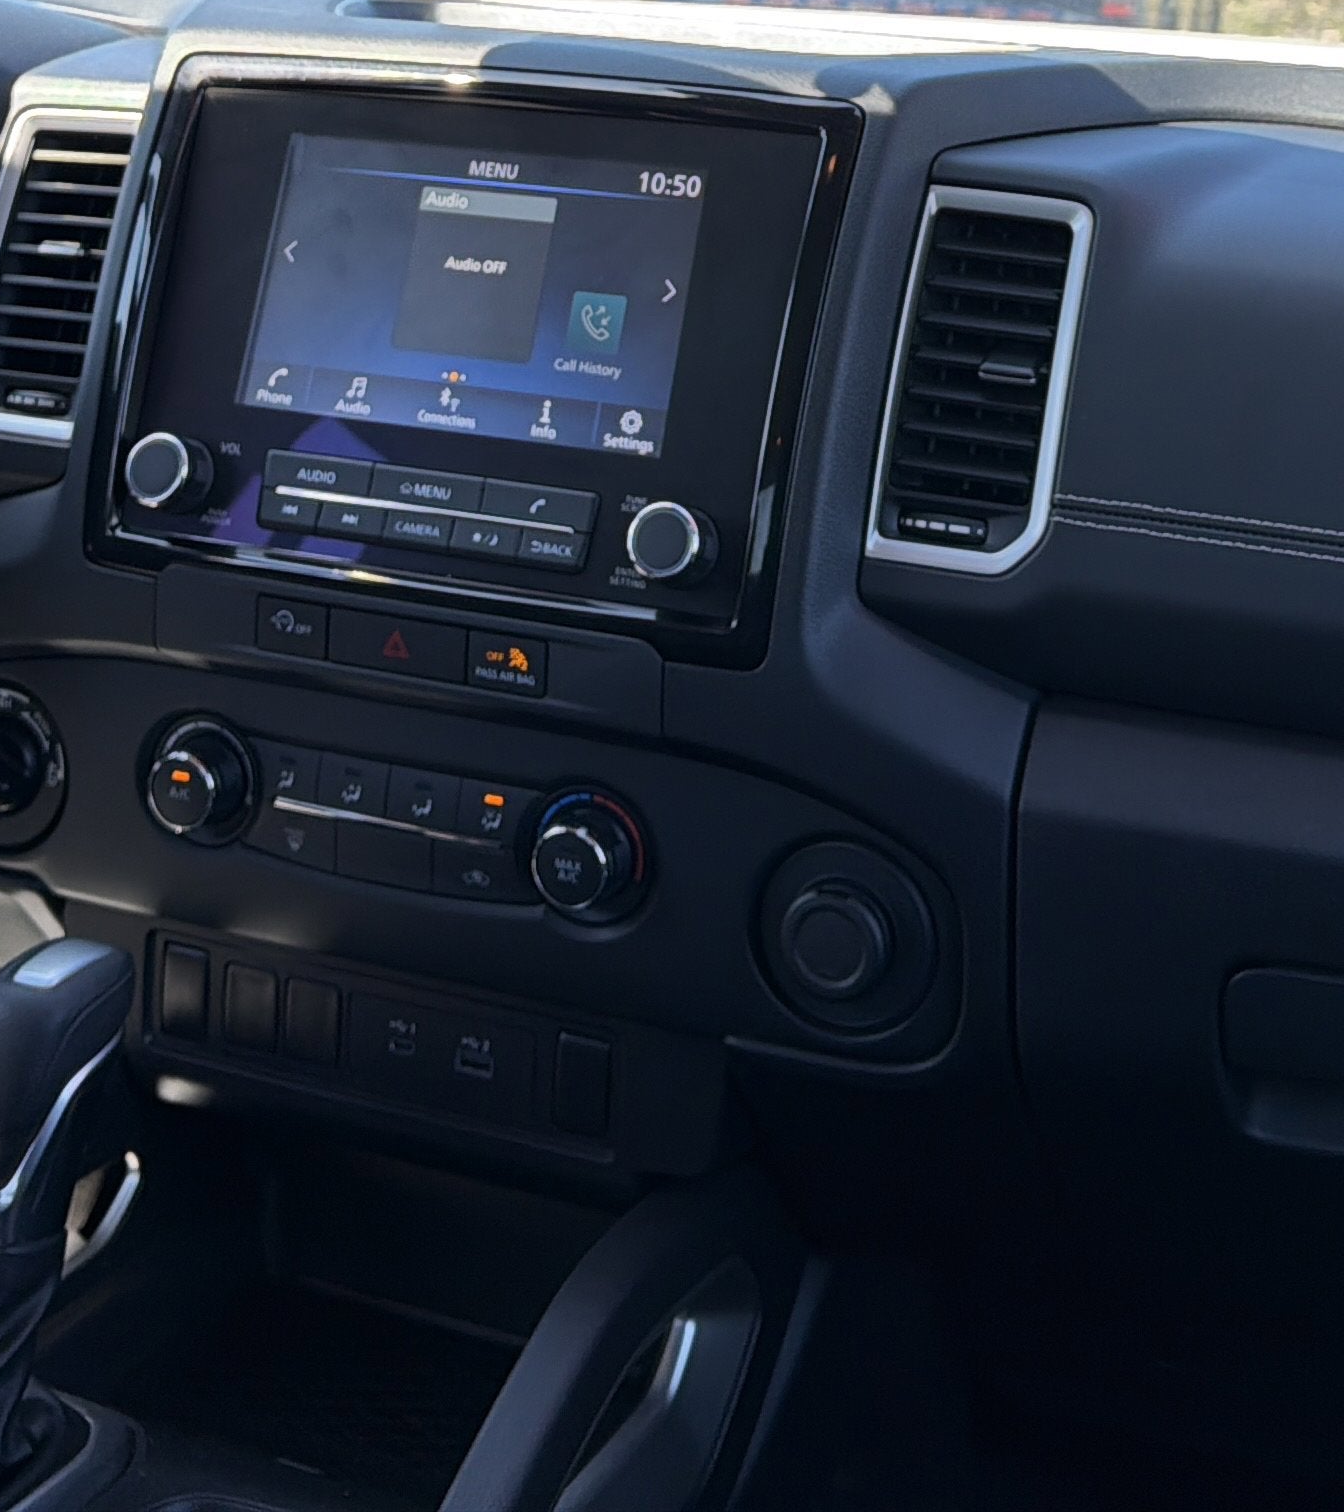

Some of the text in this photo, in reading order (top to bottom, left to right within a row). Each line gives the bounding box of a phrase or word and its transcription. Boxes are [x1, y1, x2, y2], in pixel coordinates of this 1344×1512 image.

[468, 160, 520, 180] MENU
[638, 170, 703, 200] 10:50
[424, 190, 470, 211] Audio
[443, 255, 508, 276] Audio OFF
[553, 357, 623, 379] Call History
[255, 388, 294, 407] Phone
[334, 397, 372, 417] Audio
[416, 407, 476, 430] Connections
[529, 423, 557, 441] Info
[219, 440, 243, 457] VOL
[602, 431, 655, 455] Settings
[296, 466, 337, 486] AUDIO
[413, 480, 452, 501] MENU
[394, 518, 441, 540] CAMERA
[542, 541, 573, 559] BACK
[485, 650, 505, 663] OFF
[474, 665, 536, 687] PASS AIR BAG
